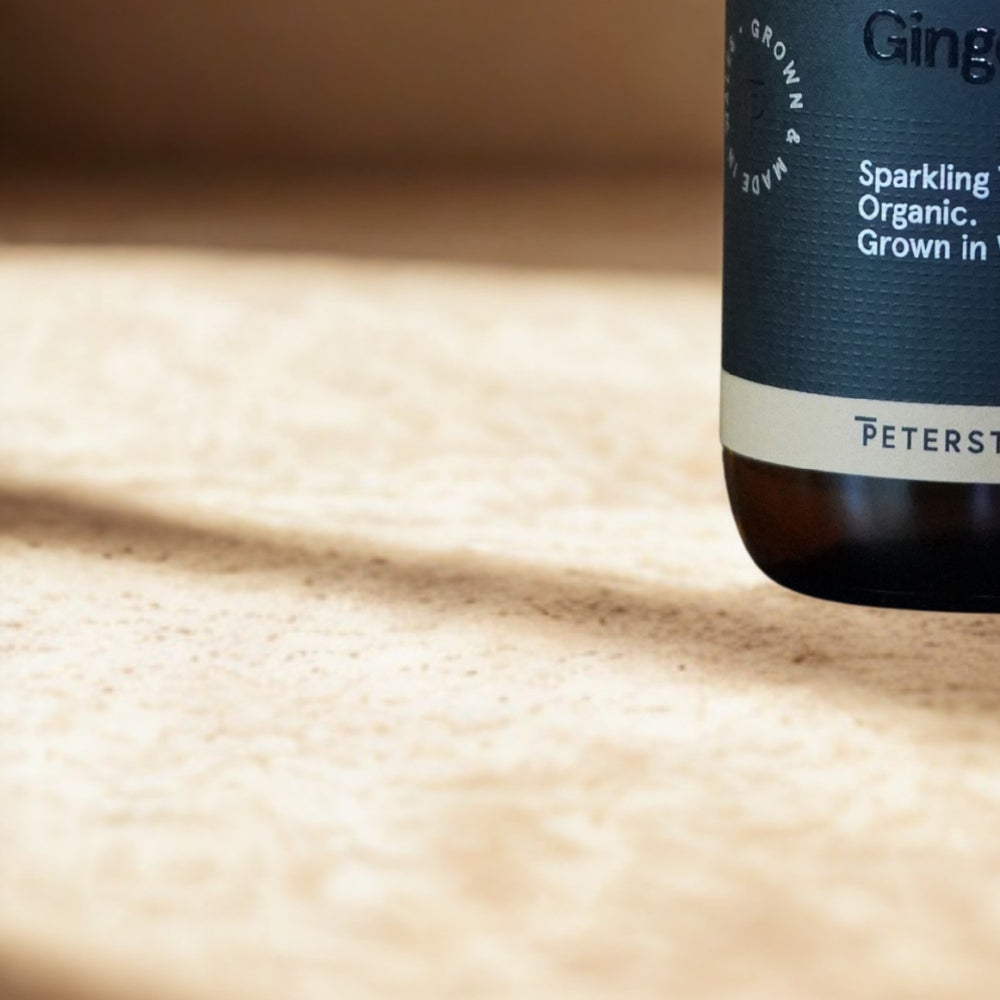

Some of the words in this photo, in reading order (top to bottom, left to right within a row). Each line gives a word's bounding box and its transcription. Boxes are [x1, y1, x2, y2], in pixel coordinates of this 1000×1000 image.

[751, 18, 803, 109] GROWN
[785, 128, 801, 144] &
[742, 157, 787, 195] MADE
[859, 160, 990, 199] Sparkling
[858, 195, 977, 230] Organic.
[857, 229, 950, 259] Grown
[962, 234, 987, 260] in
